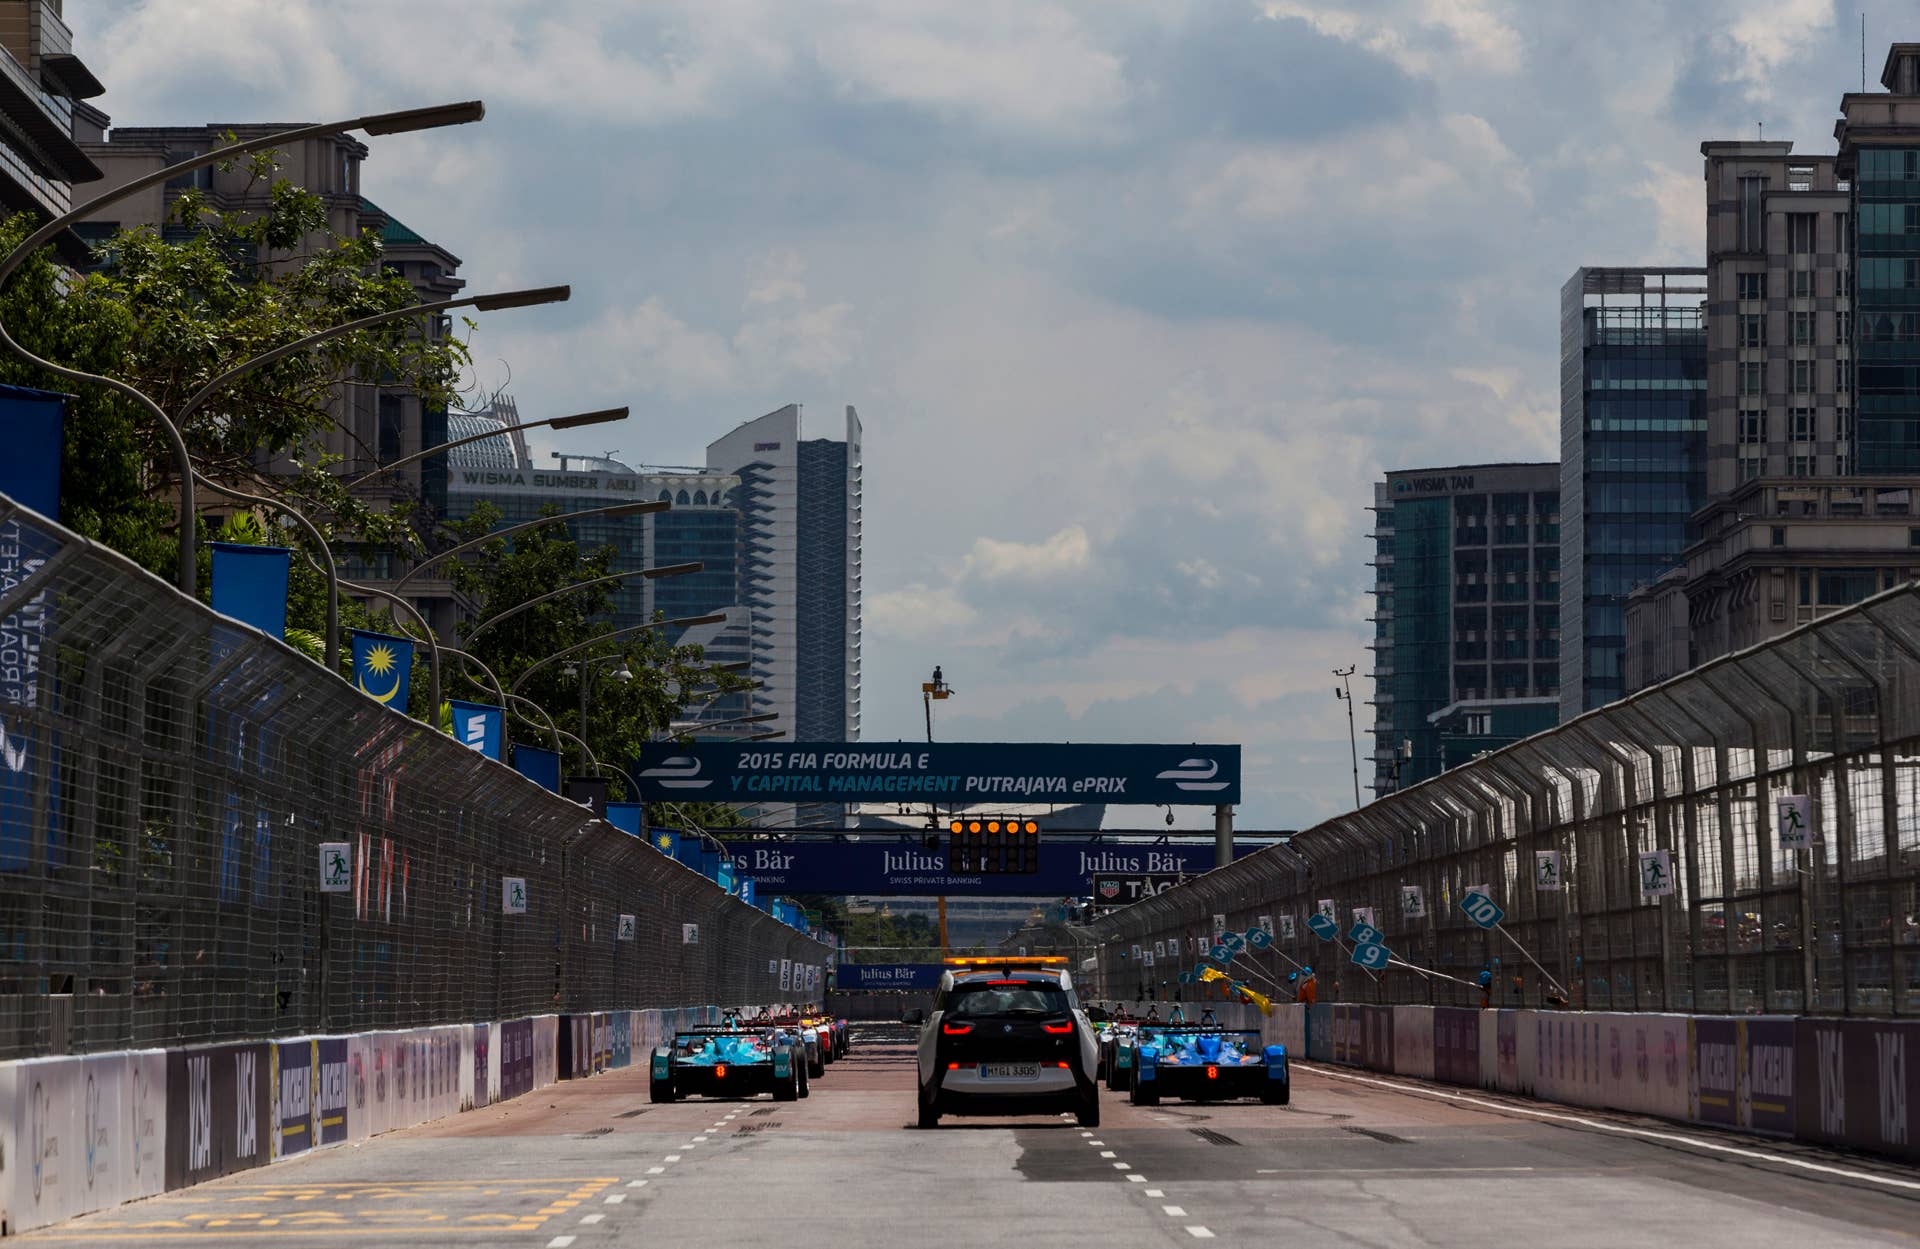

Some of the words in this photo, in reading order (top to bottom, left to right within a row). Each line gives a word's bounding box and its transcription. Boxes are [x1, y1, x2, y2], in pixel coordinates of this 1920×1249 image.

[463, 471, 525, 486] WISMA
[533, 474, 598, 489] SUMBER
[1413, 477, 1448, 492] WISMA
[1451, 475, 1474, 489] TANI
[737, 752, 783, 769] 2015
[787, 752, 818, 769] FIA
[822, 752, 912, 769] FORMULA
[917, 752, 929, 769] E
[730, 776, 744, 792] Y
[747, 776, 823, 792] CAPITAL
[828, 776, 961, 792] MANAGEMENT
[965, 776, 1068, 796] PUTRAJAYA
[1072, 777, 1128, 793] ePRIX
[754, 849, 795, 870] Bär
[882, 850, 945, 875] Julius
[1079, 851, 1140, 875] Julius
[1147, 852, 1188, 873] Bär
[889, 876, 913, 885] SWISS
[913, 876, 945, 885] PRIVATE
[946, 876, 982, 885] BANKING
[1467, 896, 1496, 923] 10
[1313, 917, 1332, 930] 7
[1225, 936, 1238, 946] 4
[1252, 930, 1265, 944] 6
[1358, 927, 1374, 942] 8
[1214, 948, 1229, 960] 5
[1362, 946, 1380, 965] 9
[860, 967, 893, 981] Julius
[895, 967, 916, 979] Bär
[655, 1066, 667, 1074] EV
[1700, 1042, 1736, 1091] MICHELIN
[1752, 1044, 1793, 1097] MICHELIN
[1815, 1029, 1846, 1136] VISA
[1874, 1031, 1908, 1145] VISA
[282, 1066, 311, 1119] MICHELIN
[187, 1055, 211, 1171] VISA
[235, 1050, 257, 1158] VISA
